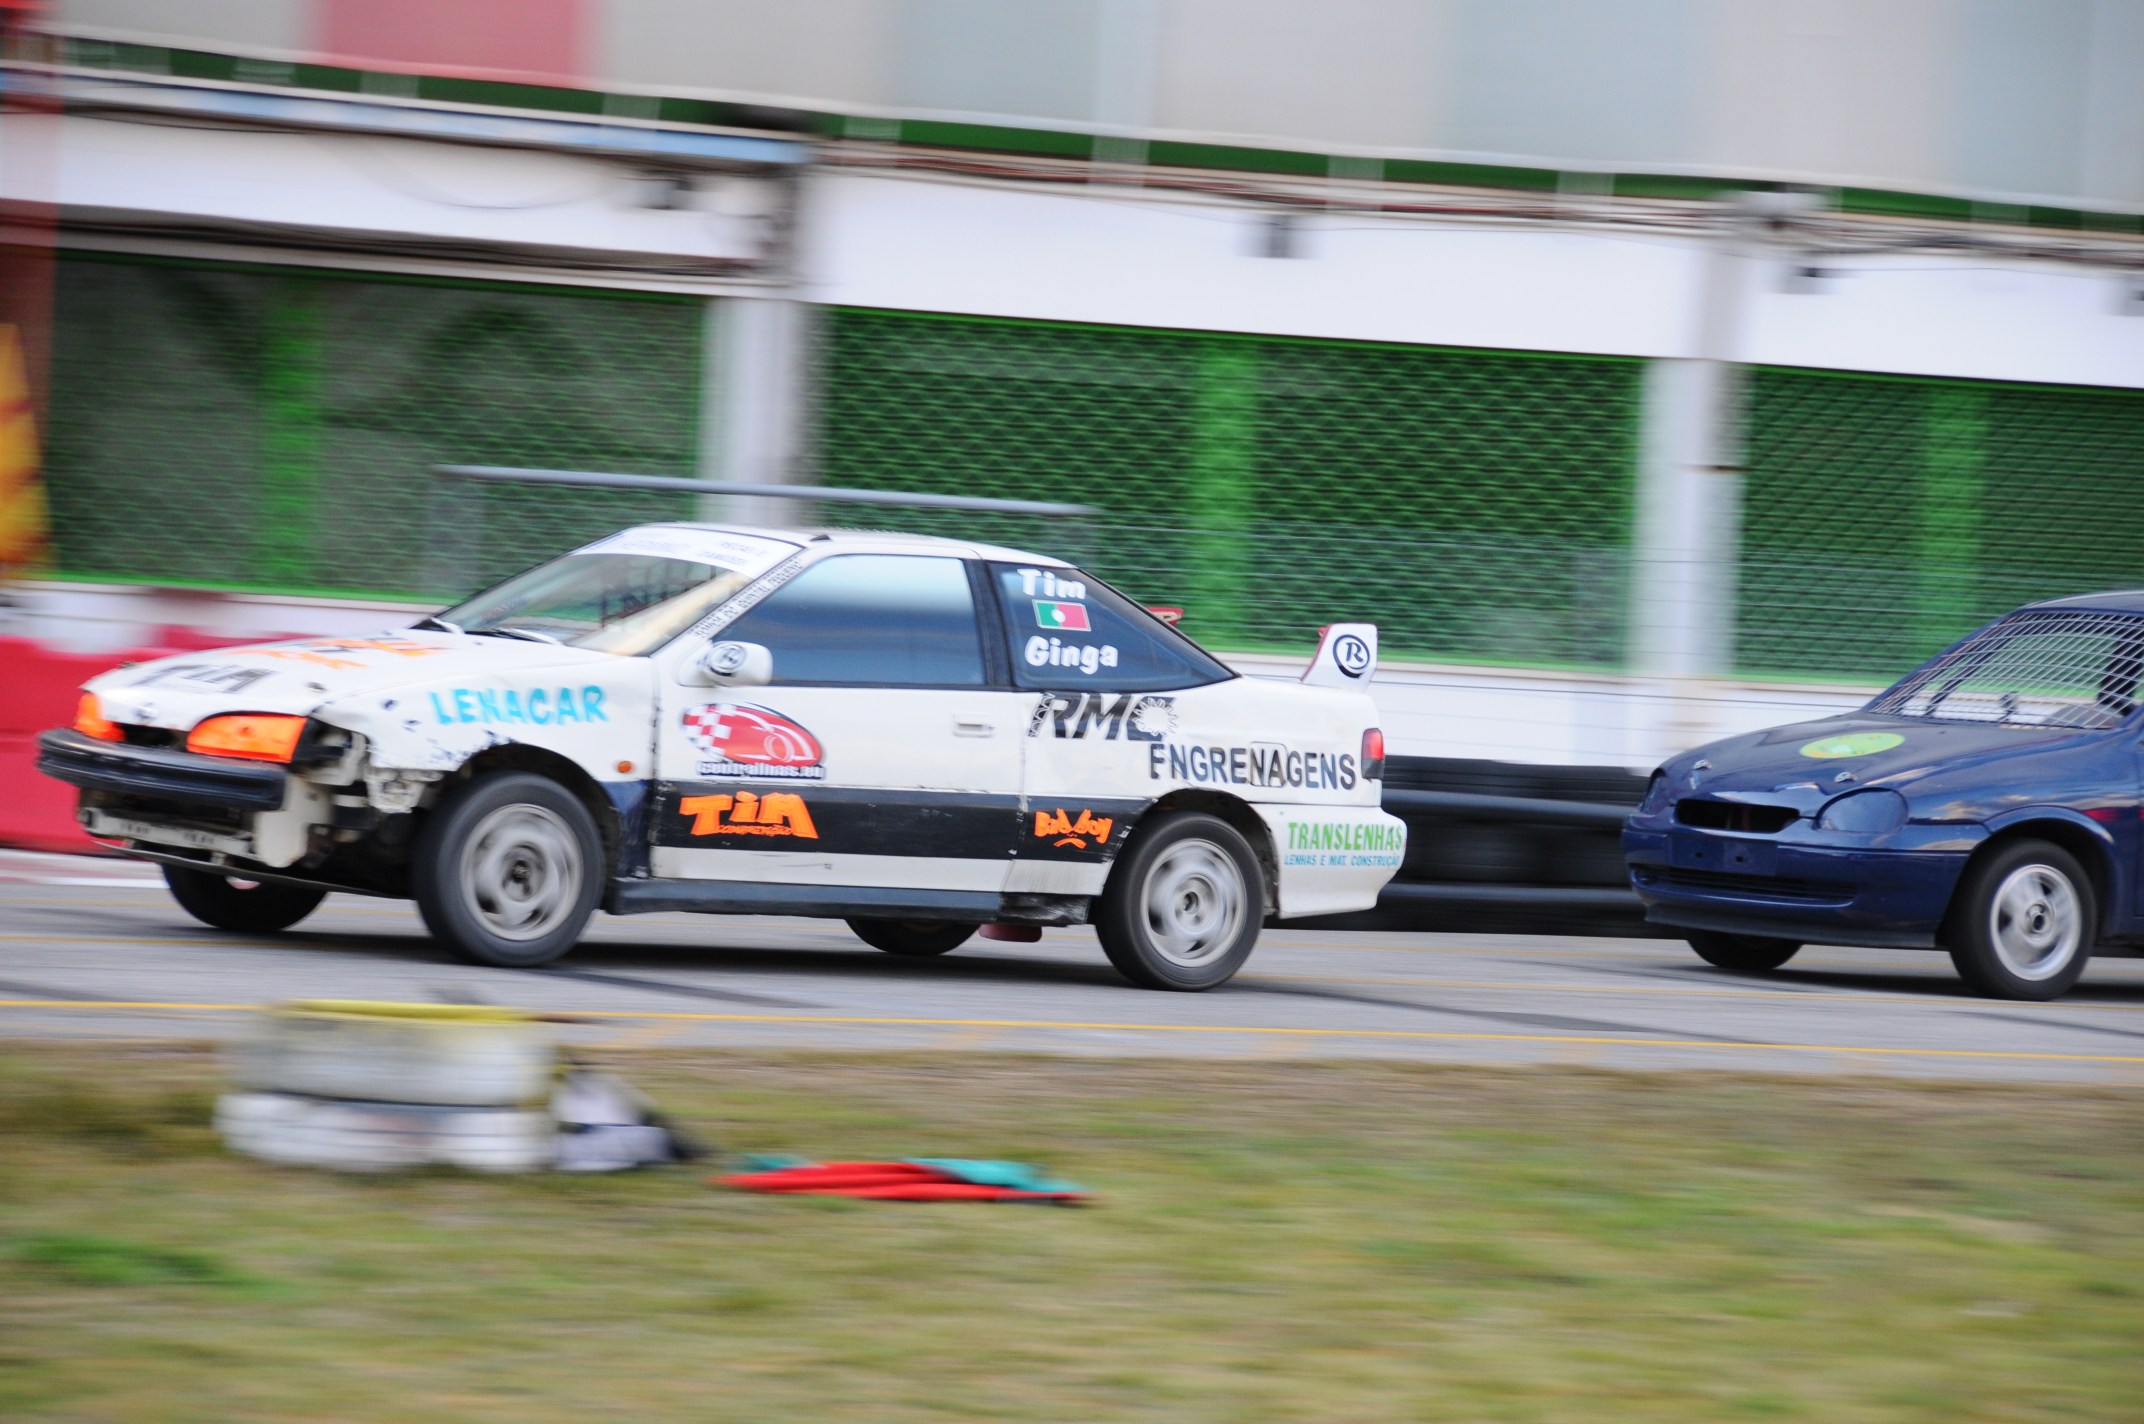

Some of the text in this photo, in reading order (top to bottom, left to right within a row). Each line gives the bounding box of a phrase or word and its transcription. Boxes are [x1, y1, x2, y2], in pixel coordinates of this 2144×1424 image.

[1017, 568, 1086, 600] Tim
[1024, 635, 1119, 675] Ginga
[428, 684, 608, 725] LENACAR
[1150, 743, 1356, 790] ENGRENAGENS
[1288, 822, 1402, 851] TRANSLENHAS
[1284, 854, 1317, 866] LENHAS
[1320, 855, 1325, 866] E
